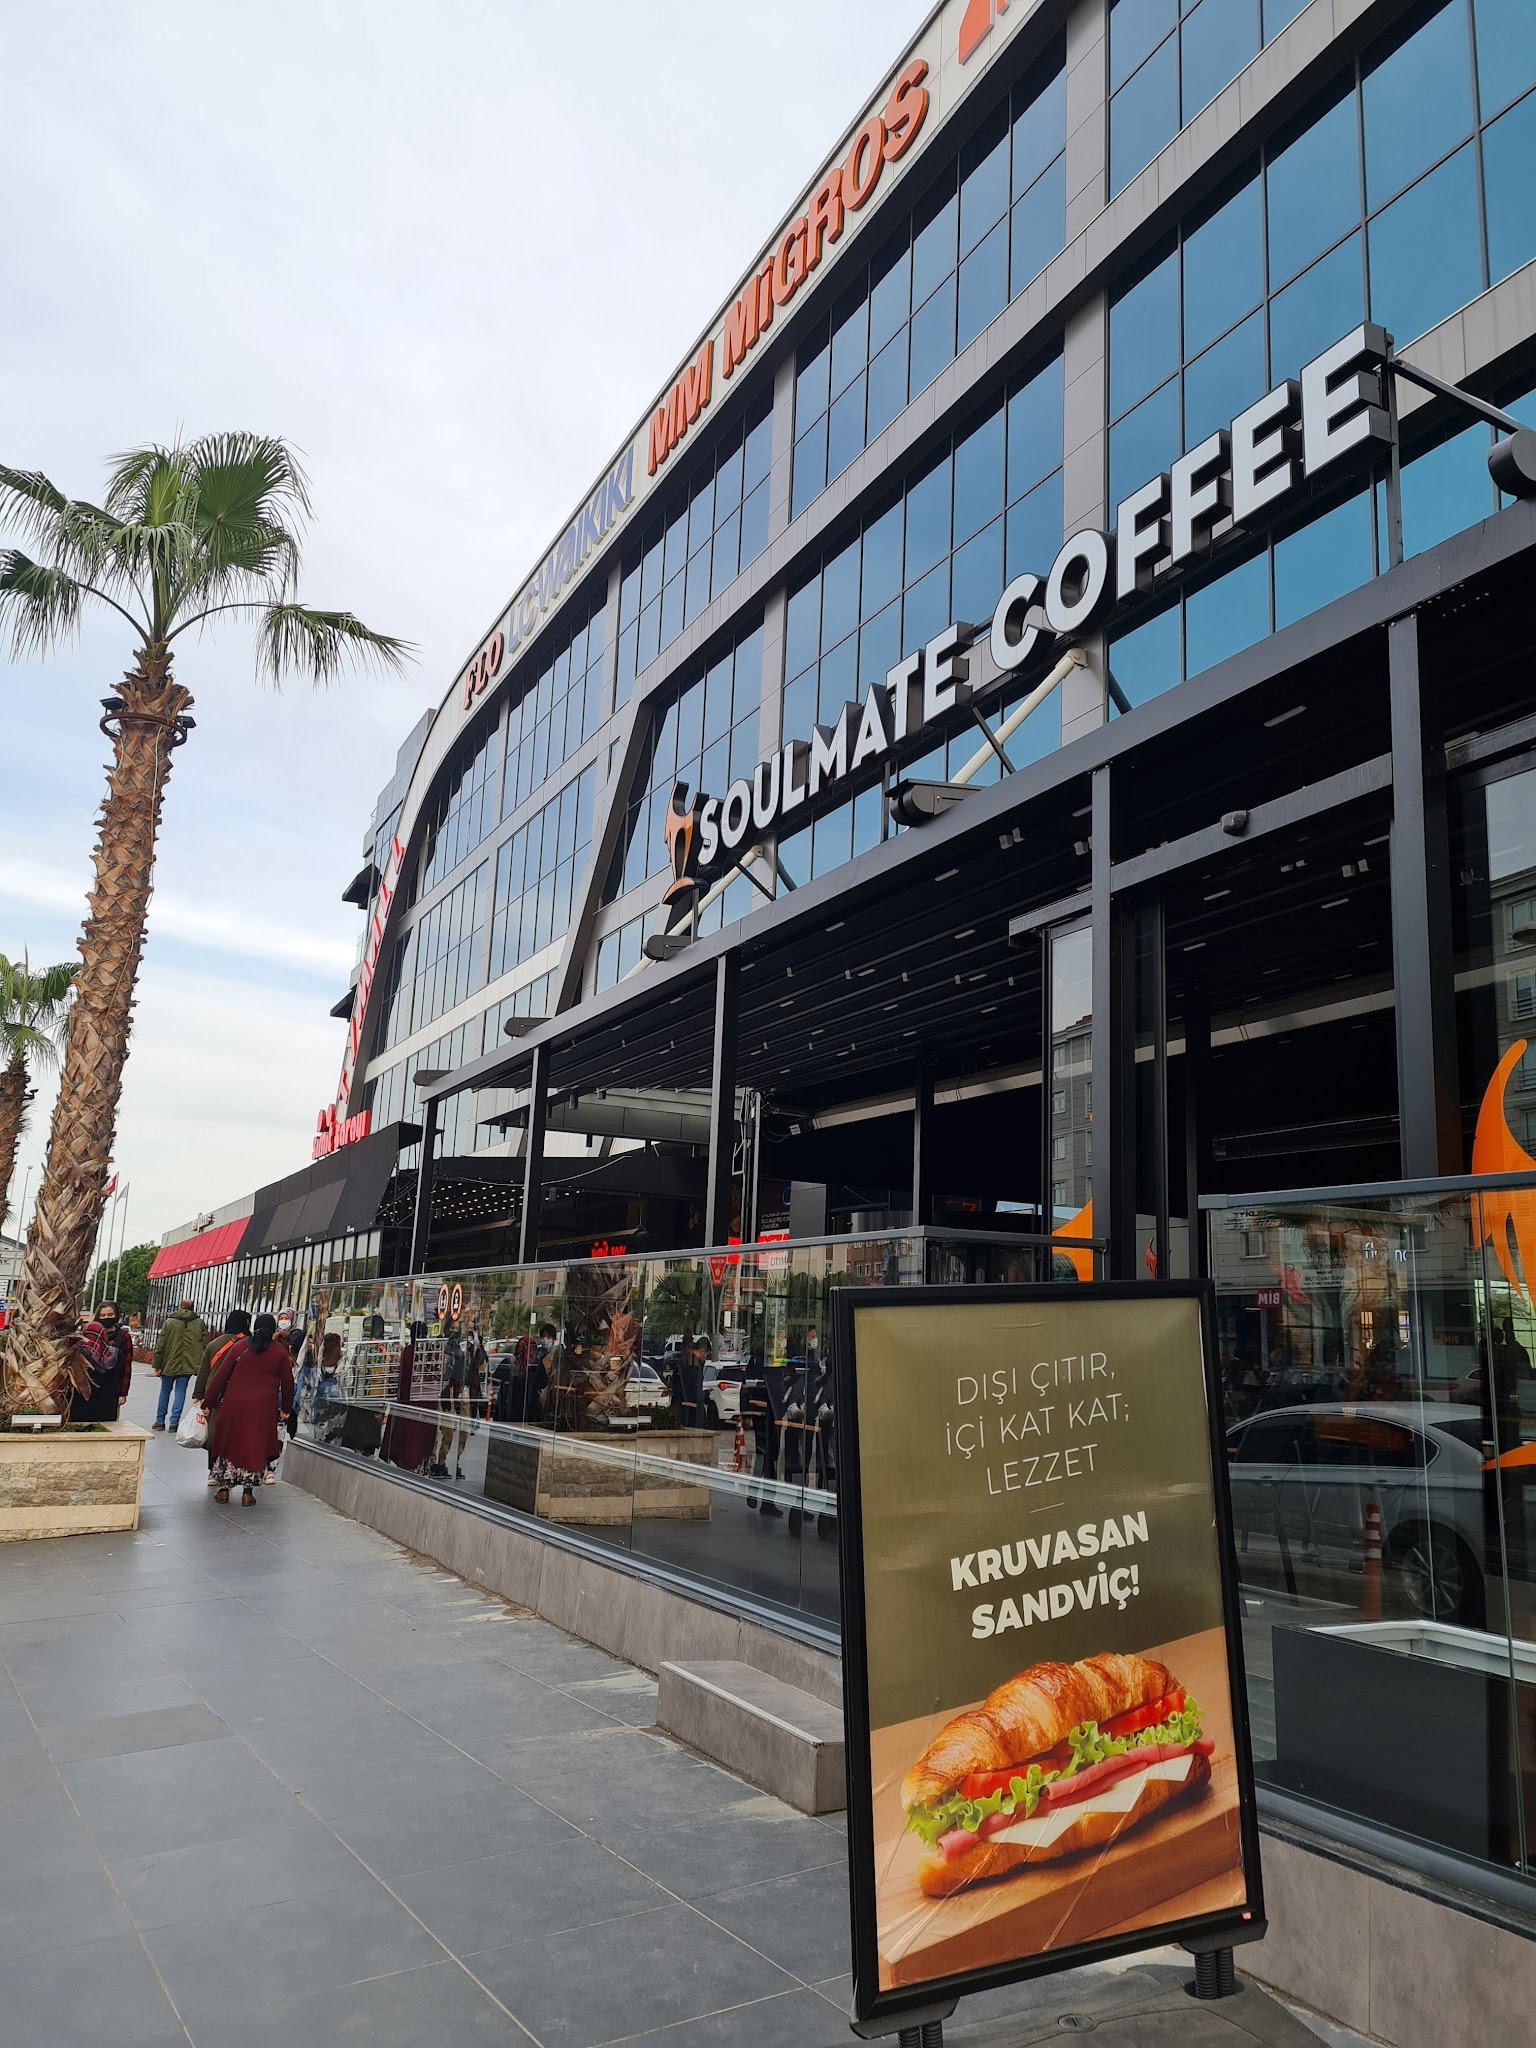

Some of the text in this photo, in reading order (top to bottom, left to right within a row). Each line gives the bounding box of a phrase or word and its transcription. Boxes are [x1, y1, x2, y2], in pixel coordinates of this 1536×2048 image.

[722, 59, 930, 380] MİGROS
[697, 319, 1394, 866] SOULMATE COFFEE
[462, 631, 505, 710] FLO
[956, 1351, 1116, 1406] DIŞI ÇITIR,
[945, 1392, 1130, 1460] İÇİ KAT KAT;
[985, 1443, 1099, 1496] LEZZET
[949, 1510, 1150, 1592] KRUVASAN
[970, 1561, 1141, 1640] SANDVİÇ!
